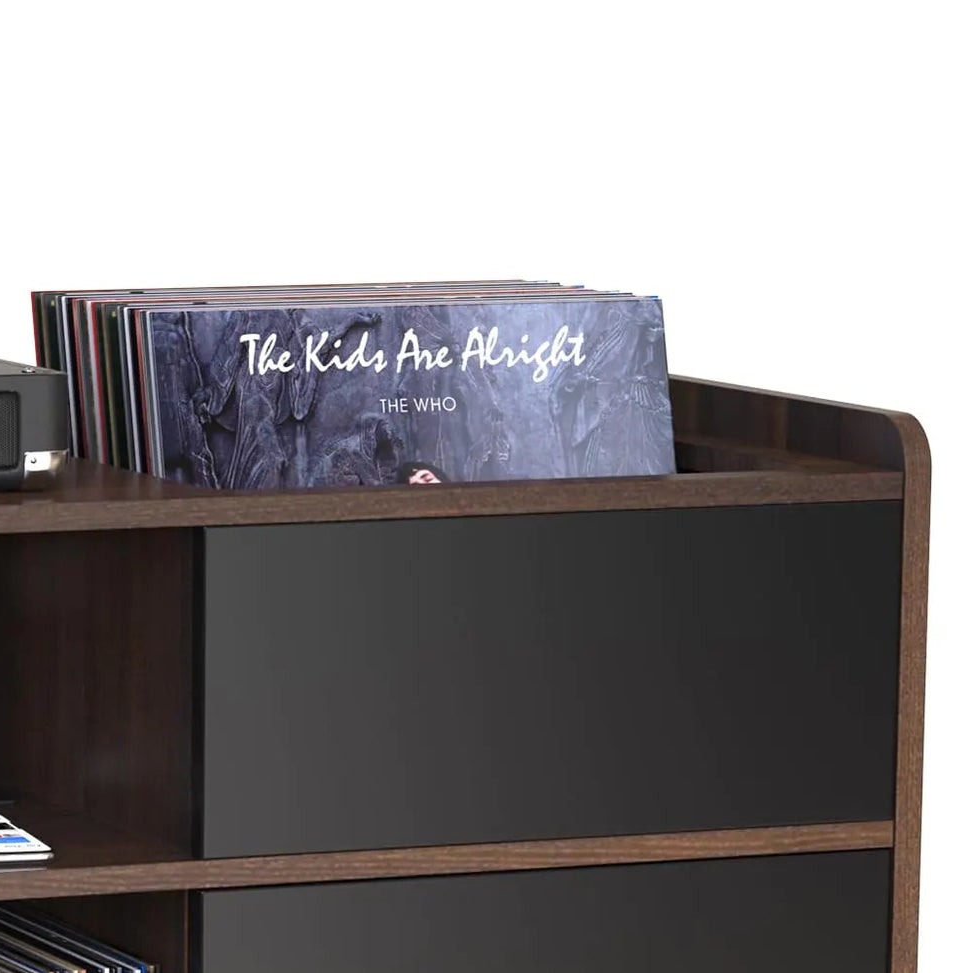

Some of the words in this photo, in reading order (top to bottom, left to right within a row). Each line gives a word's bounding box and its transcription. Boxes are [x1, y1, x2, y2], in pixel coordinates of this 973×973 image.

[239, 333, 295, 375] The
[306, 331, 388, 373] Kids
[396, 328, 453, 373] Are
[461, 325, 586, 383] Alright
[380, 399, 408, 413] THE
[414, 397, 456, 412] WHO
